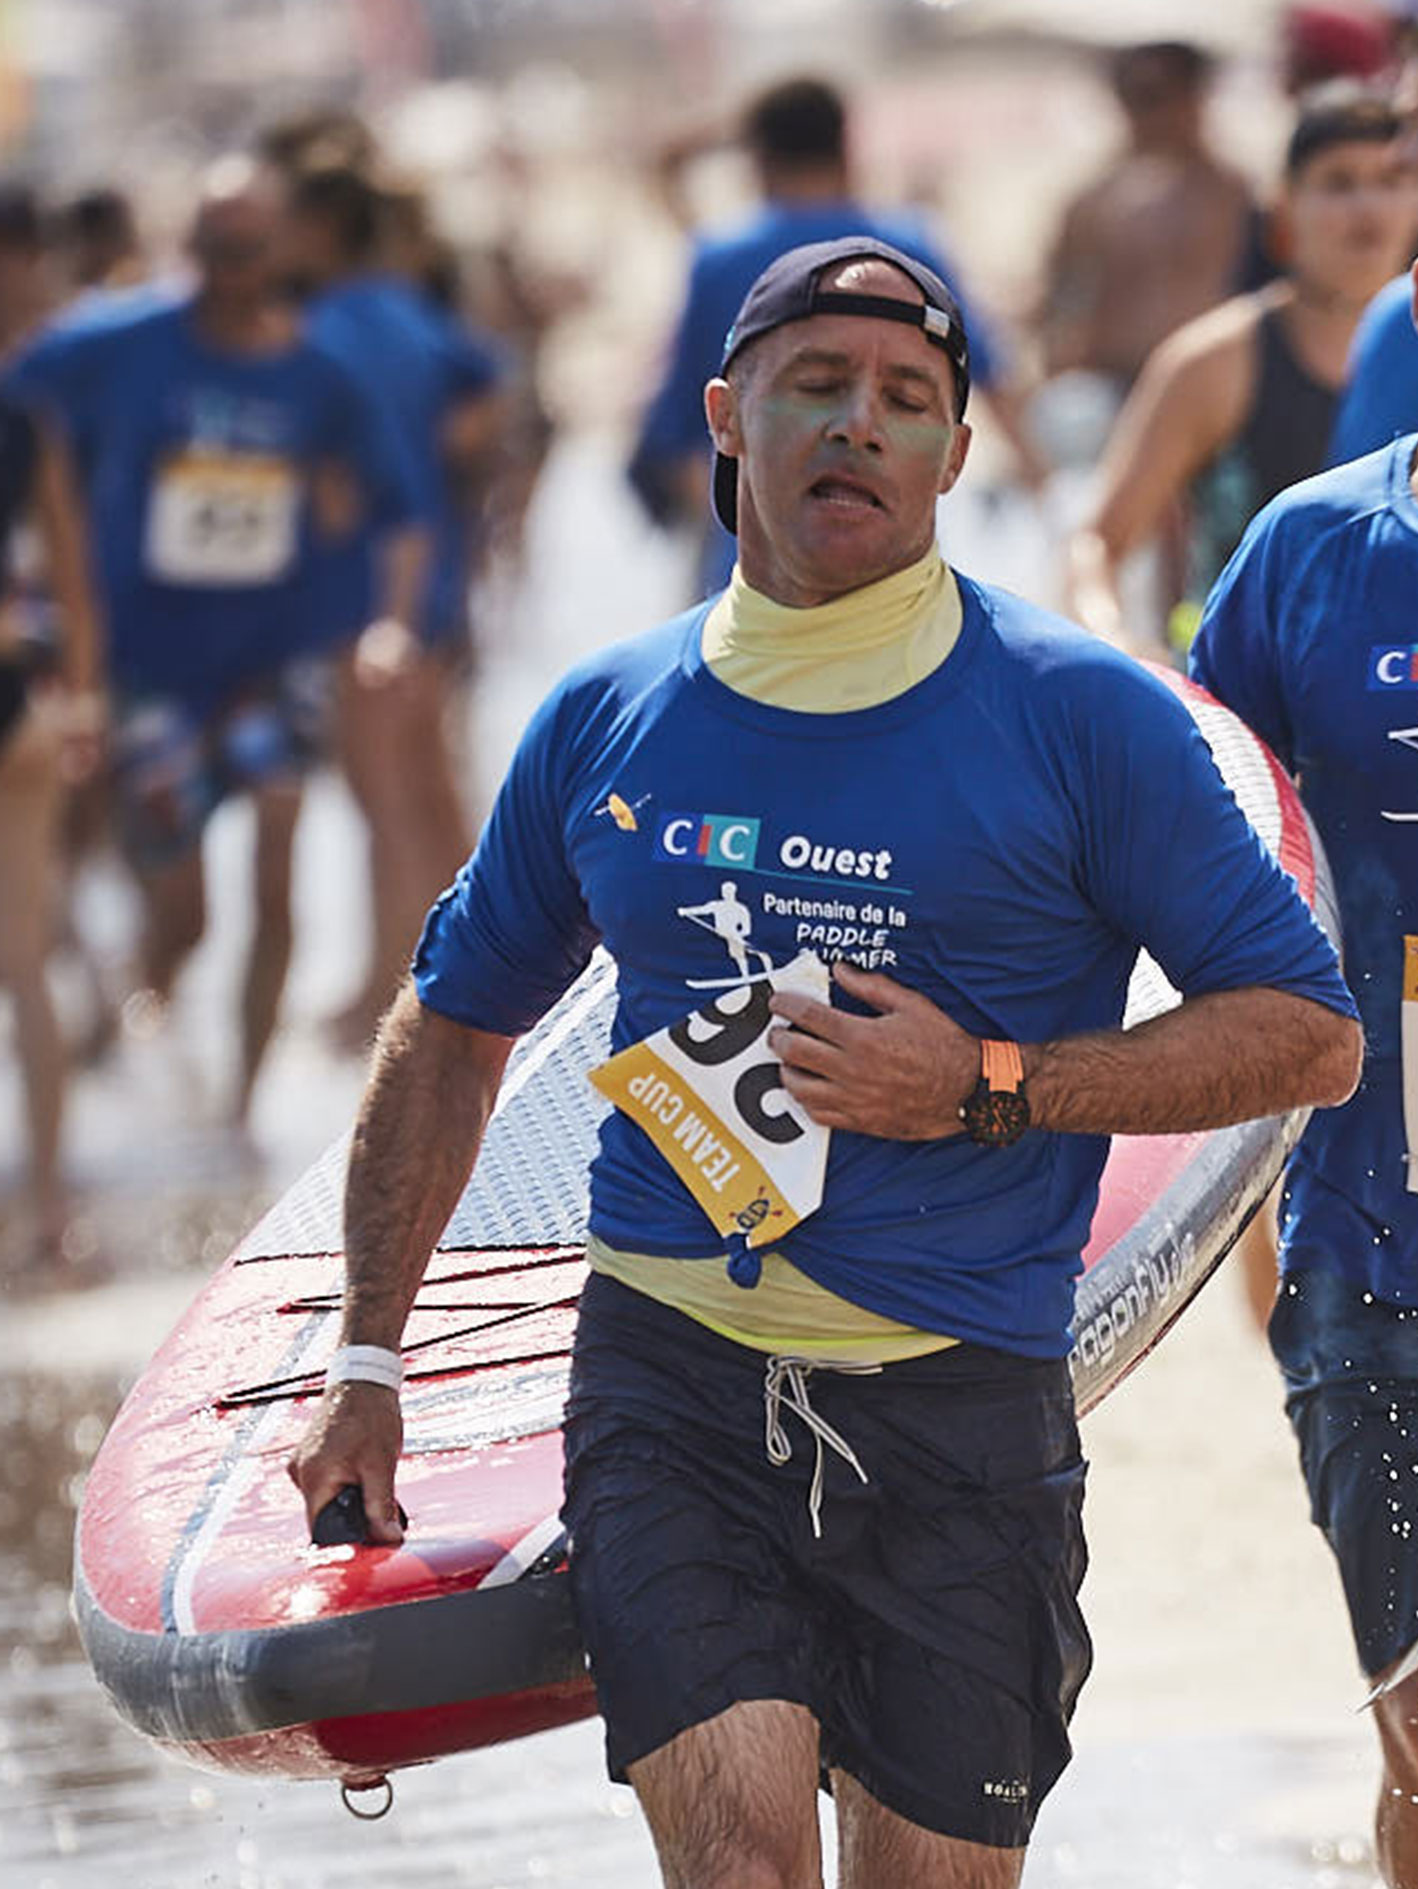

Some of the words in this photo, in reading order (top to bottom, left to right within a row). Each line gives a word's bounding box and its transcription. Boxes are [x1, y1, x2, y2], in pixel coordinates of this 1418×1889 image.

[663, 819, 751, 861] CIC
[780, 835, 892, 880] Ouest
[763, 892, 856, 922] Partenaire
[860, 903, 884, 924] de
[888, 905, 906, 927] la
[796, 922, 889, 947] PADDLE
[799, 947, 897, 969] MMER
[628, 1072, 688, 1131] CUP
[672, 1117, 741, 1193] TEAM
[1067, 1253, 1171, 1380] ragonfly
